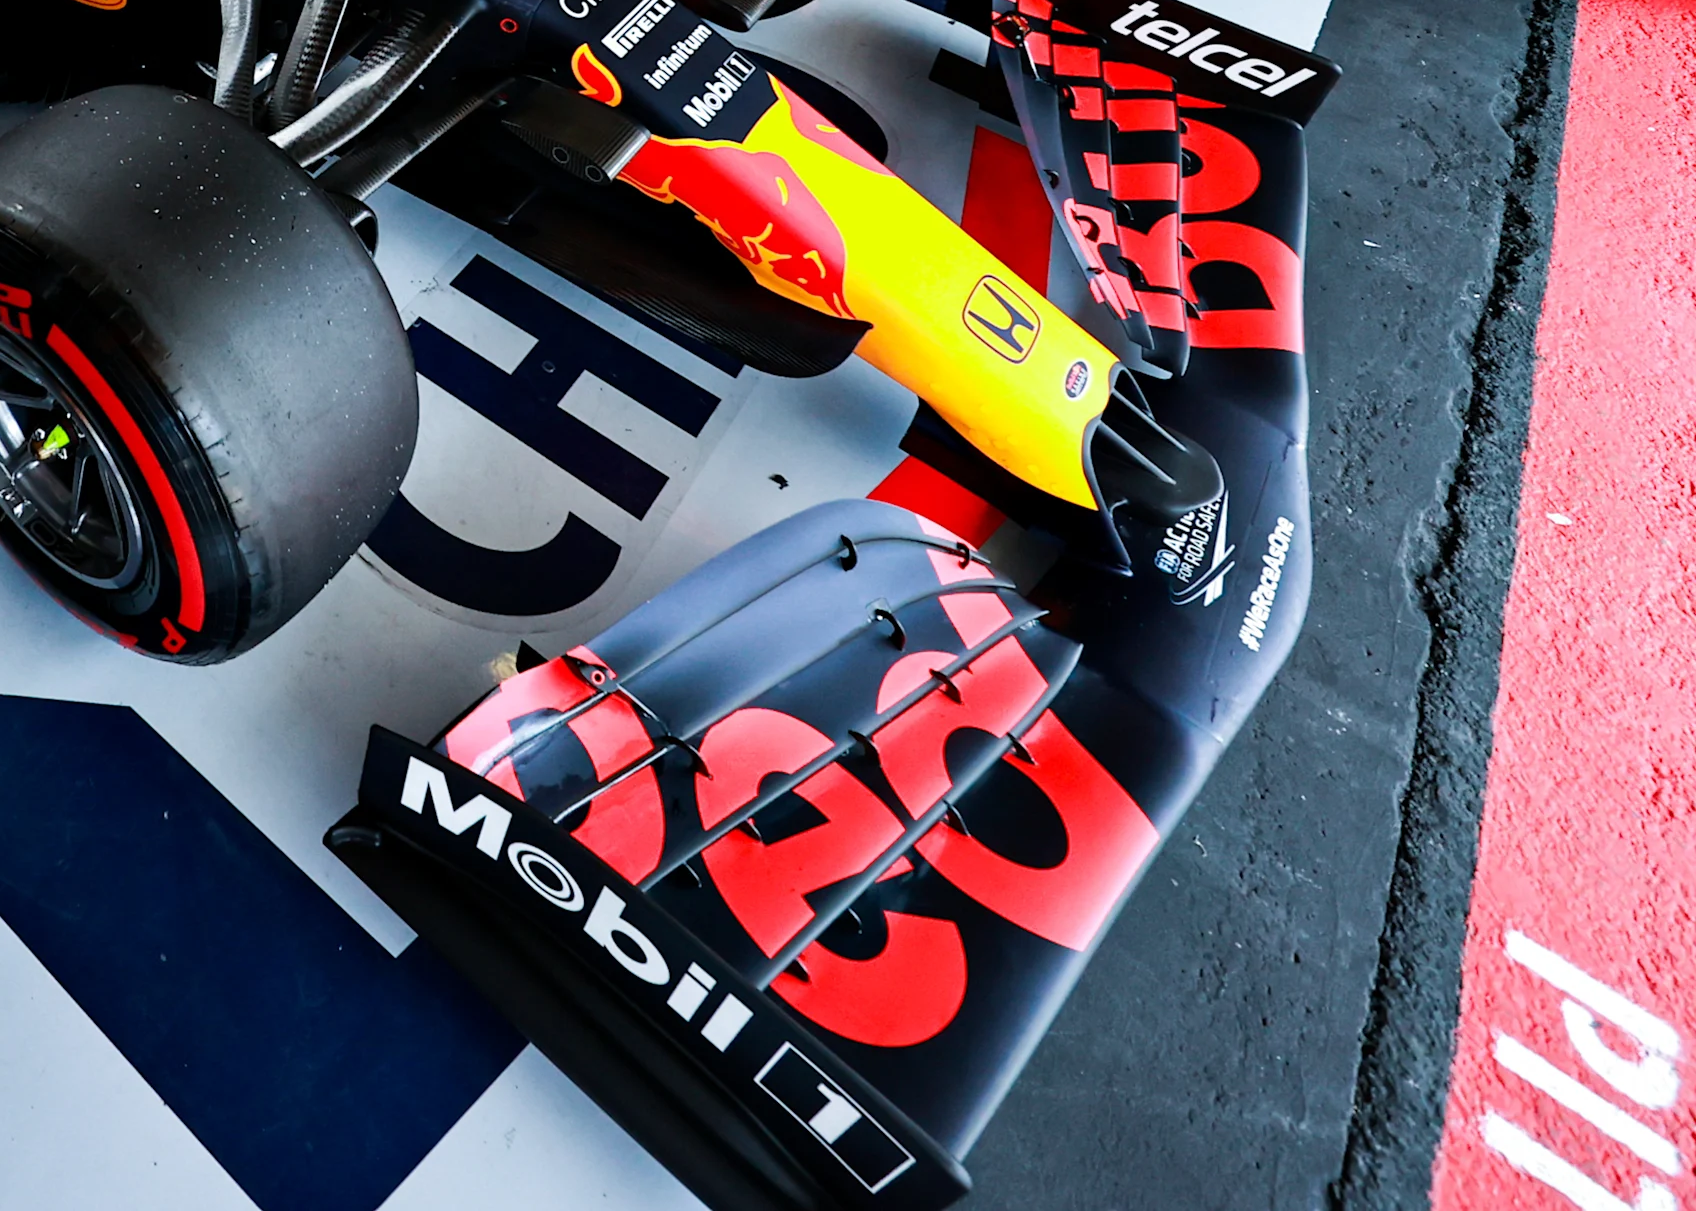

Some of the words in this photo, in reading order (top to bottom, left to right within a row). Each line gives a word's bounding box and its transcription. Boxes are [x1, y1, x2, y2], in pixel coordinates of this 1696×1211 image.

[643, 23, 713, 91] infinitum
[1109, 0, 1318, 99] telcel
[682, 65, 742, 128] Mobil
[1177, 561, 1195, 584] FOR
[1183, 535, 1209, 568] ROAD
[1238, 516, 1296, 653] #WeRaceAsOne
[400, 755, 755, 1054] Mobil
